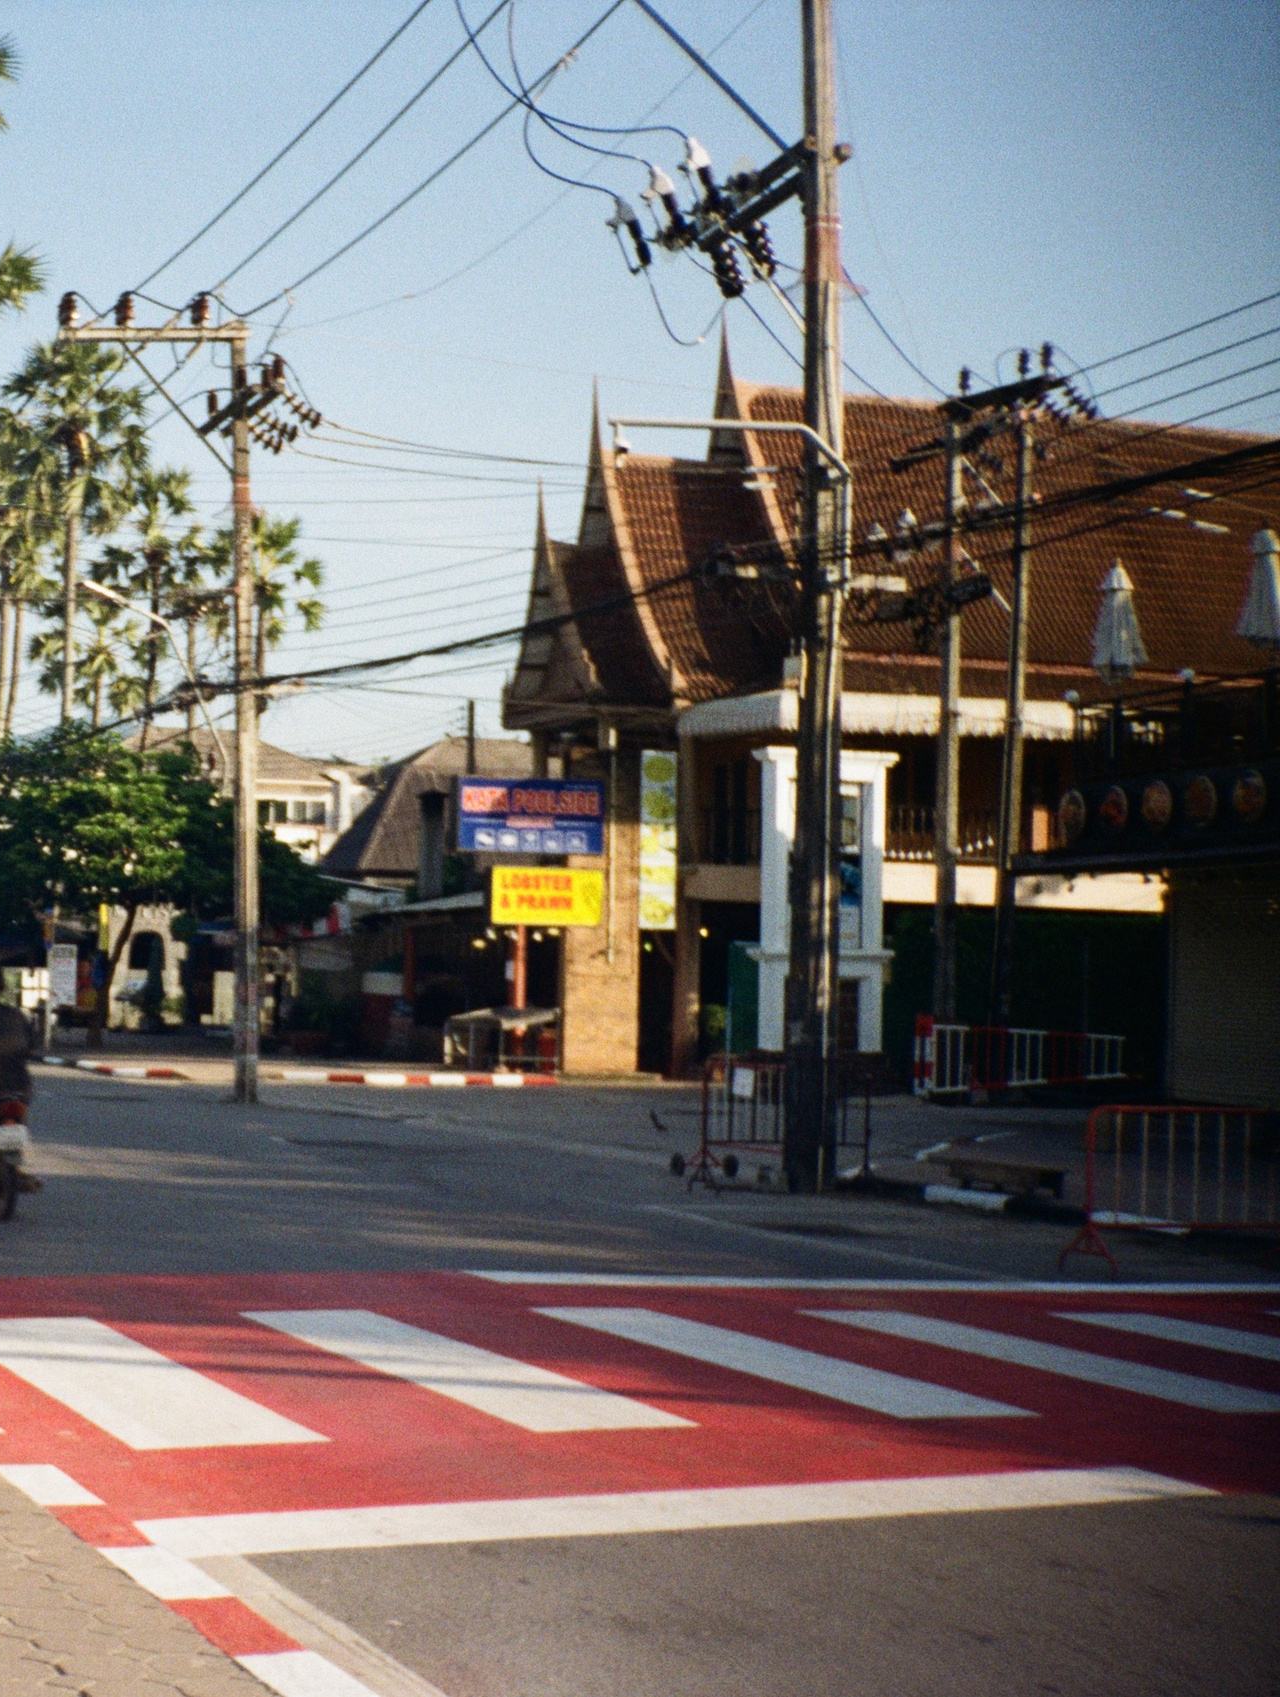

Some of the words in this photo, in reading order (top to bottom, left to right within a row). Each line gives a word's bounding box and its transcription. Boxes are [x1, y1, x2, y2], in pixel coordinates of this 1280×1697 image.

[462, 787, 509, 812] KATA
[513, 789, 599, 814] POOLSIDE
[501, 873, 572, 890] LOBSTER
[517, 895, 572, 909] PRAWN
